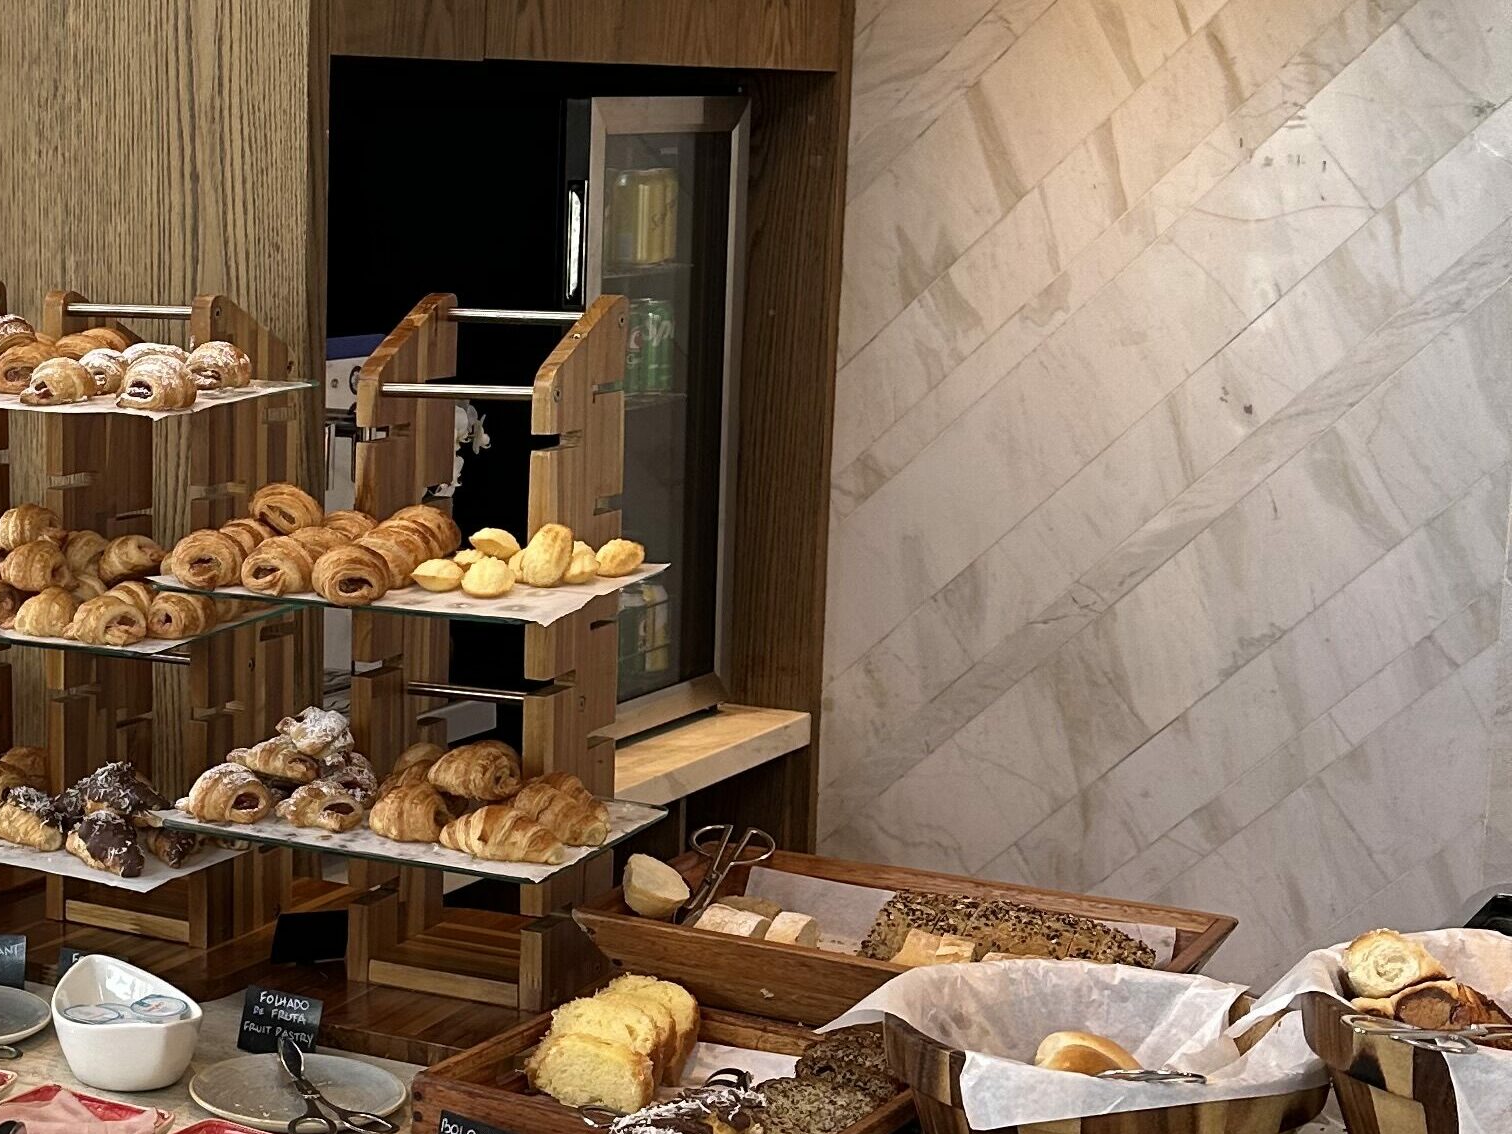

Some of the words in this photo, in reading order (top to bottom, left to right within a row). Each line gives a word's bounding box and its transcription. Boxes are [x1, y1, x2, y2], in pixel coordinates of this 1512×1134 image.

[259, 990, 310, 1011] FOLHADO
[271, 1008, 307, 1025] FRUTA
[243, 1020, 273, 1035] FRUIT
[274, 1026, 314, 1049] PASTRY
